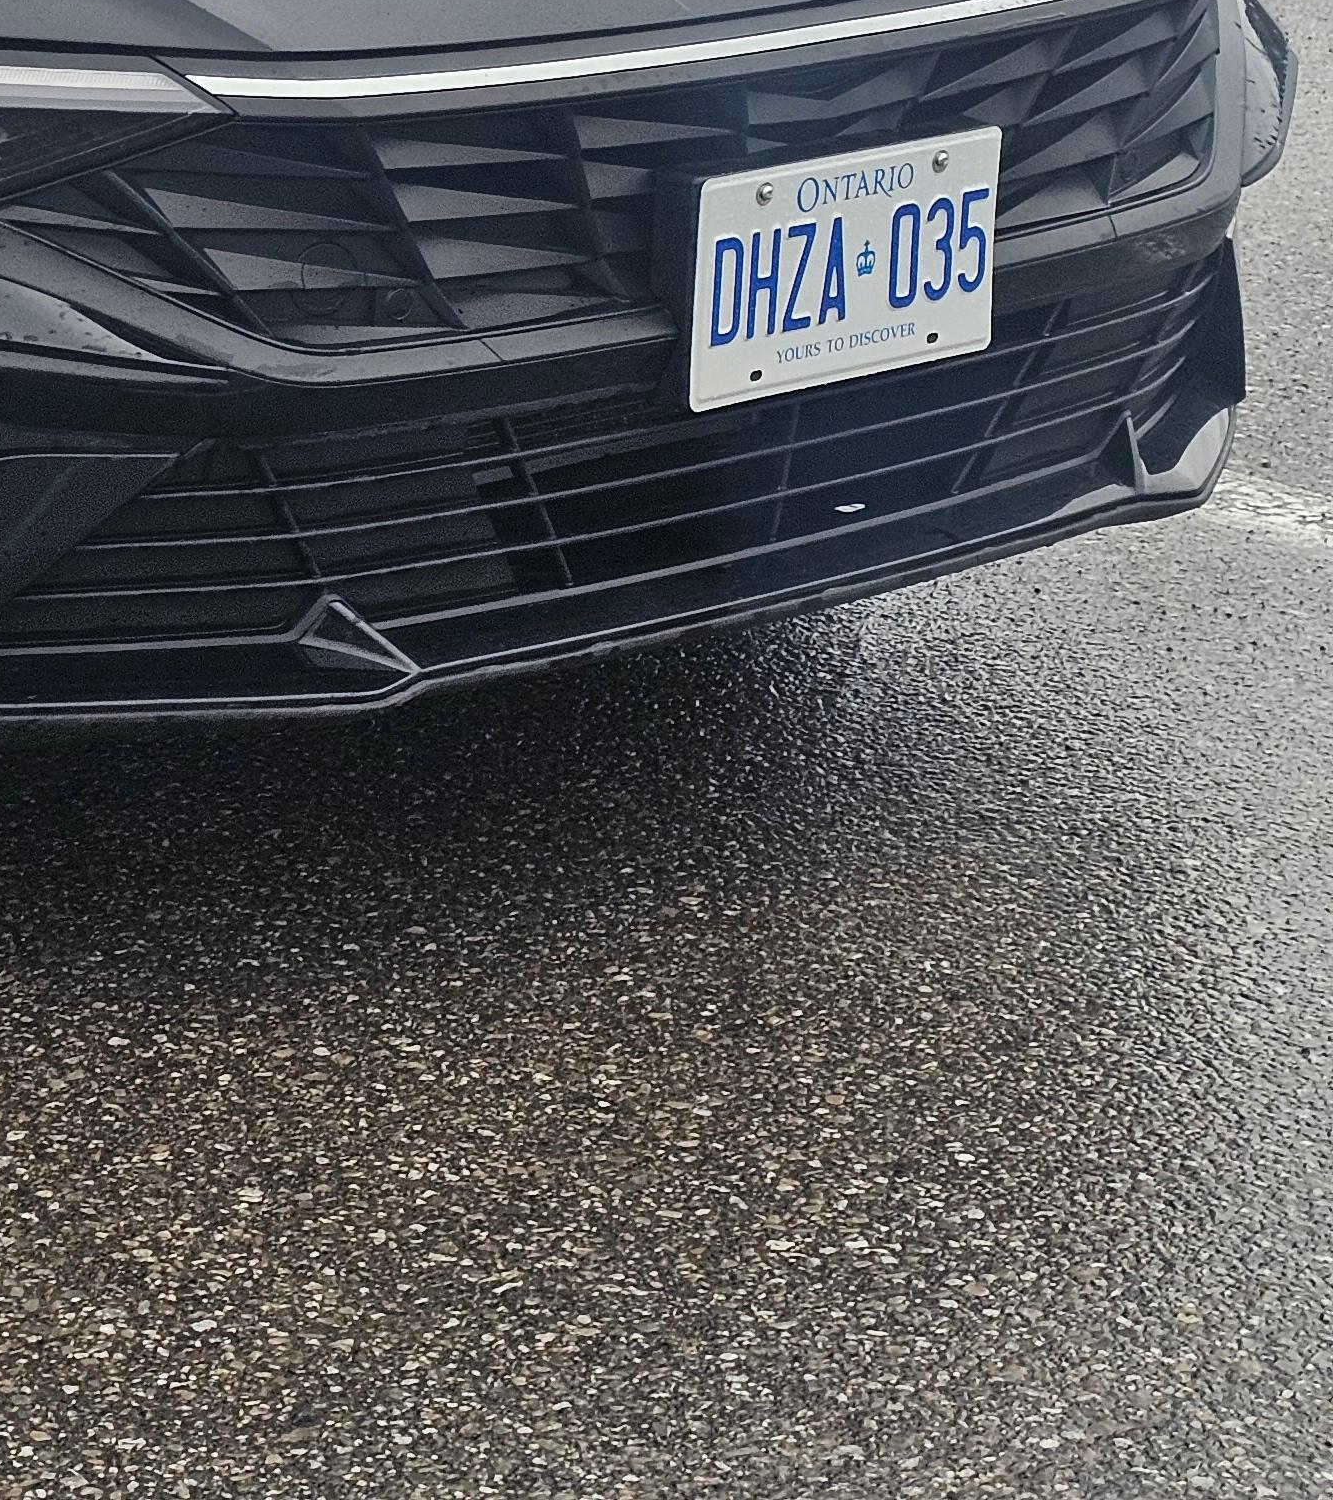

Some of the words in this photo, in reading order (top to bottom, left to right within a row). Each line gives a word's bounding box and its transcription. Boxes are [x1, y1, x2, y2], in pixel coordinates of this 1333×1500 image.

[796, 162, 915, 213] ONTARIO
[710, 217, 846, 347] DHZA
[888, 188, 989, 309] 035
[776, 341, 821, 364] YOURS
[826, 336, 844, 353] TO
[849, 322, 916, 349] DISCOVER
